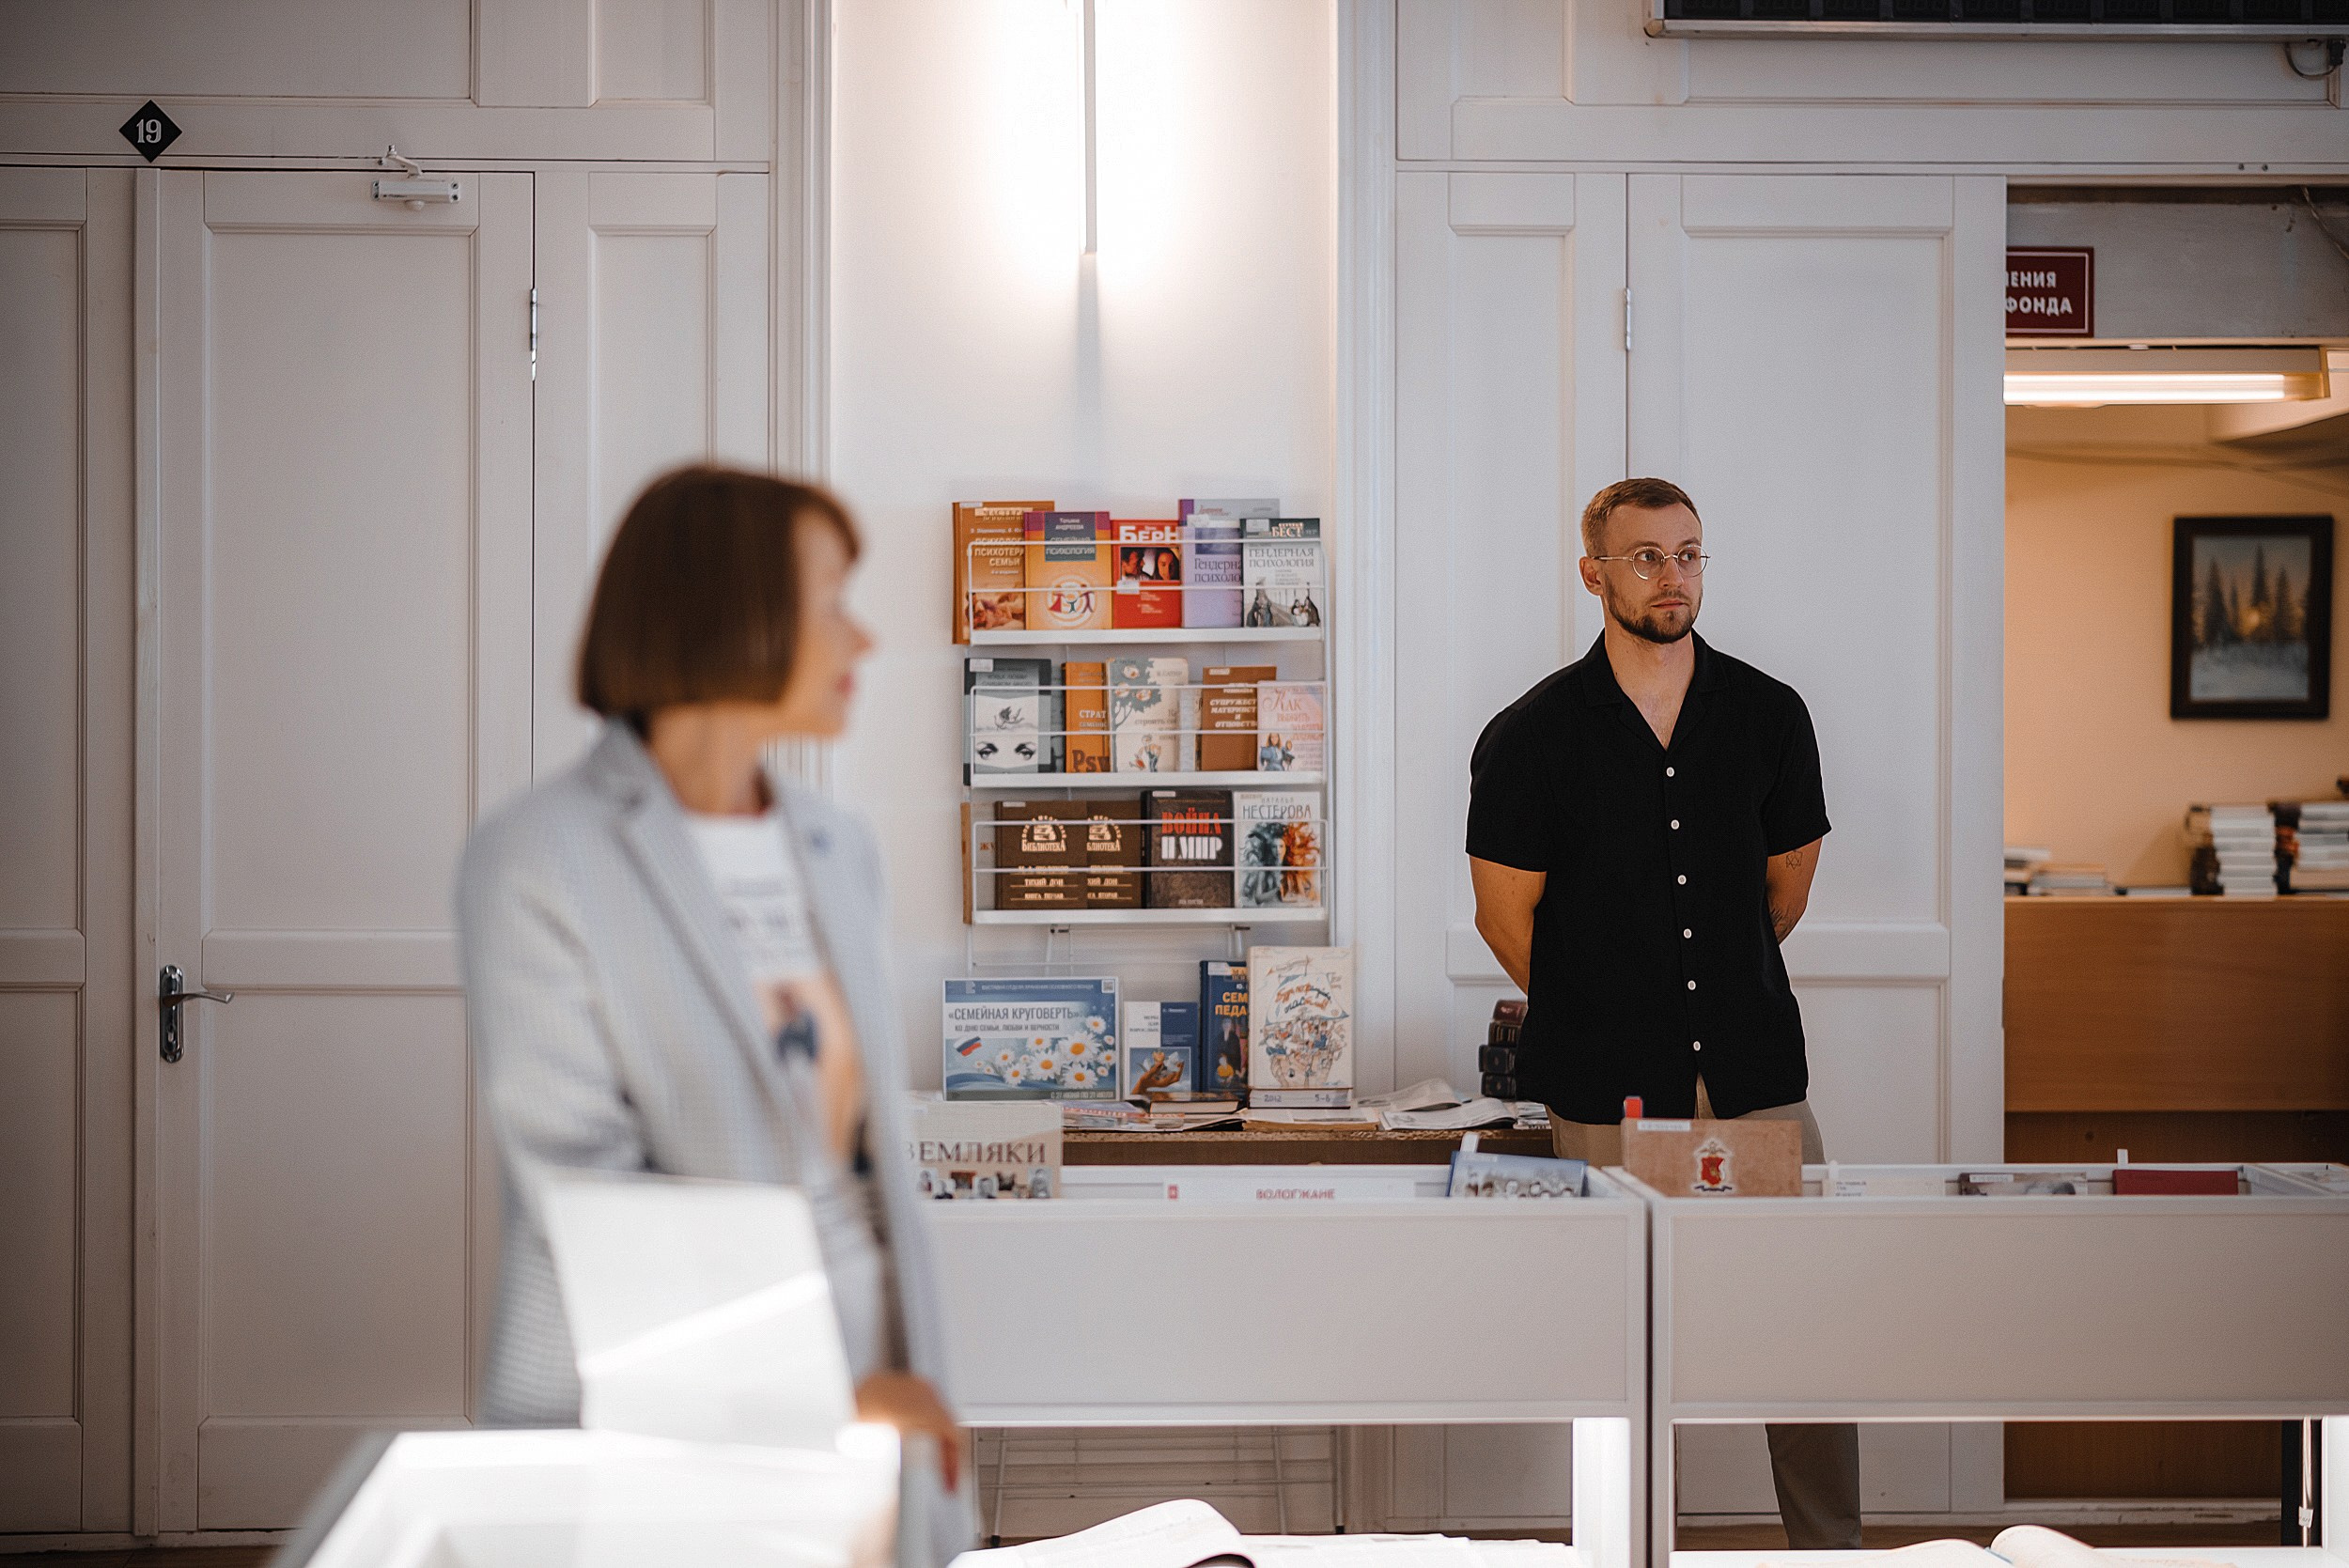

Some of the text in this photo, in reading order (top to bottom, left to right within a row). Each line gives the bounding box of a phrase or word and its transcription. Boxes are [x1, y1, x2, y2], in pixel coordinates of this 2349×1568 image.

[136, 118, 162, 144] 19
[2006, 296, 2073, 317] ФОНДА
[1046, 547, 1096, 555] ПСИХОЛОГИЯ
[1249, 548, 1315, 558] ГЕНДЕРНАЯ
[988, 558, 1020, 567] СЕМЬИ
[1249, 559, 1315, 567] ПСИХОЛОГИЯ
[1242, 804, 1312, 820] НЕСТЕРОВА
[1161, 807, 1221, 834] ВОЙНА
[948, 1005, 1081, 1021] «СЕМЕЙНАЯ КРУГОВЕРТЬ»
[1215, 1004, 1248, 1017] ПЕДА
[1264, 1094, 1282, 1103] 2012
[1255, 1188, 1335, 1200] ВОЛОГЖАНЕ
